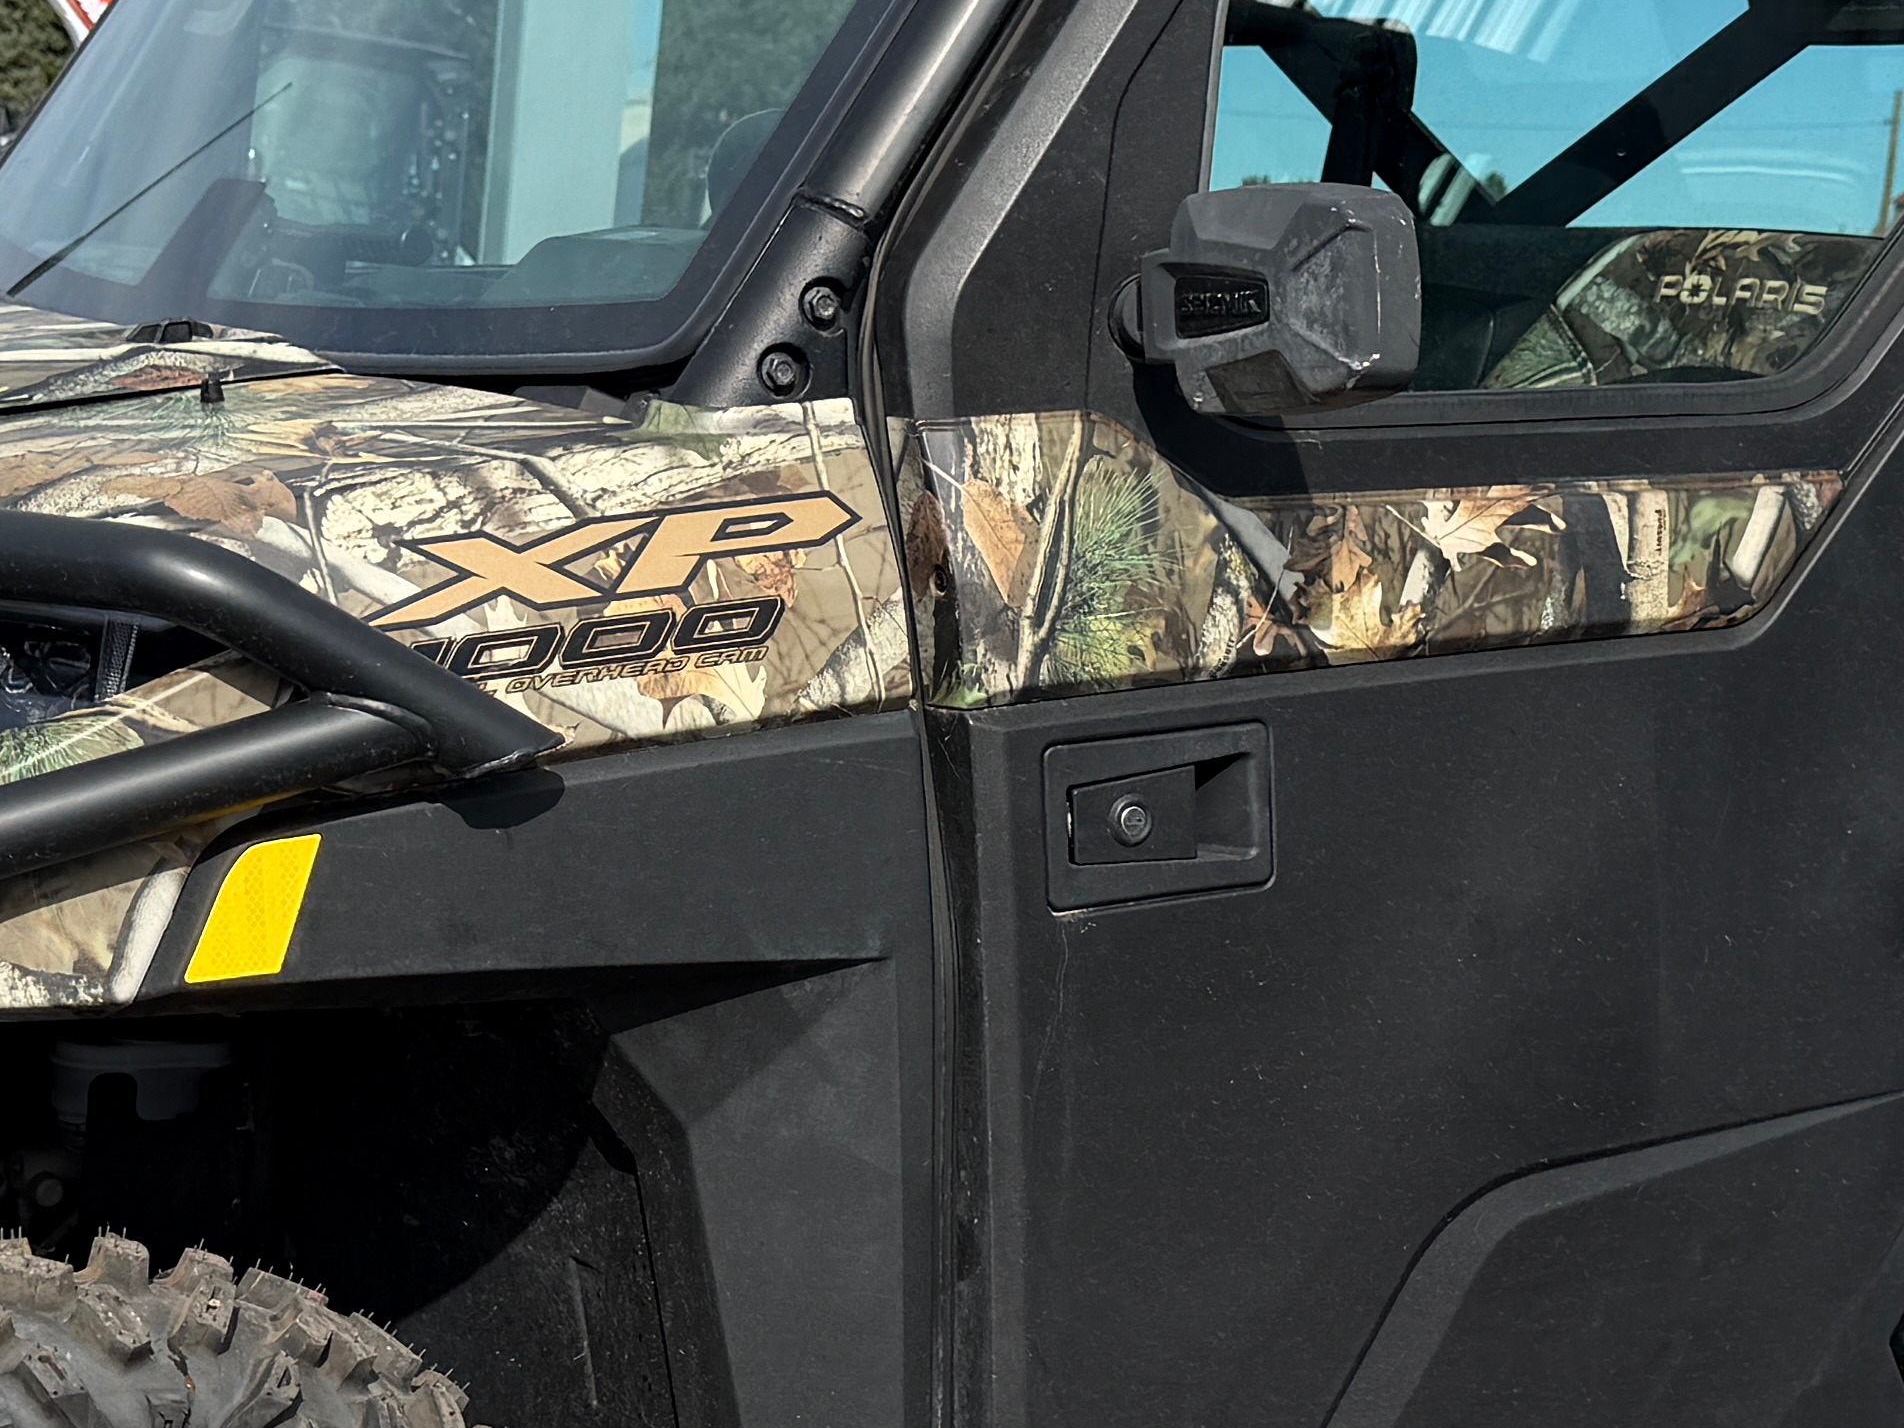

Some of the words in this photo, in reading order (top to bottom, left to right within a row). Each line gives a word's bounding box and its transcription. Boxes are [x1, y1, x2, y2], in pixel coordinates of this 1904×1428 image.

[1653, 274, 1828, 315] POLARIS
[367, 490, 862, 630] XP
[505, 656, 691, 696] OVERHEAD
[693, 644, 769, 670] CAM
